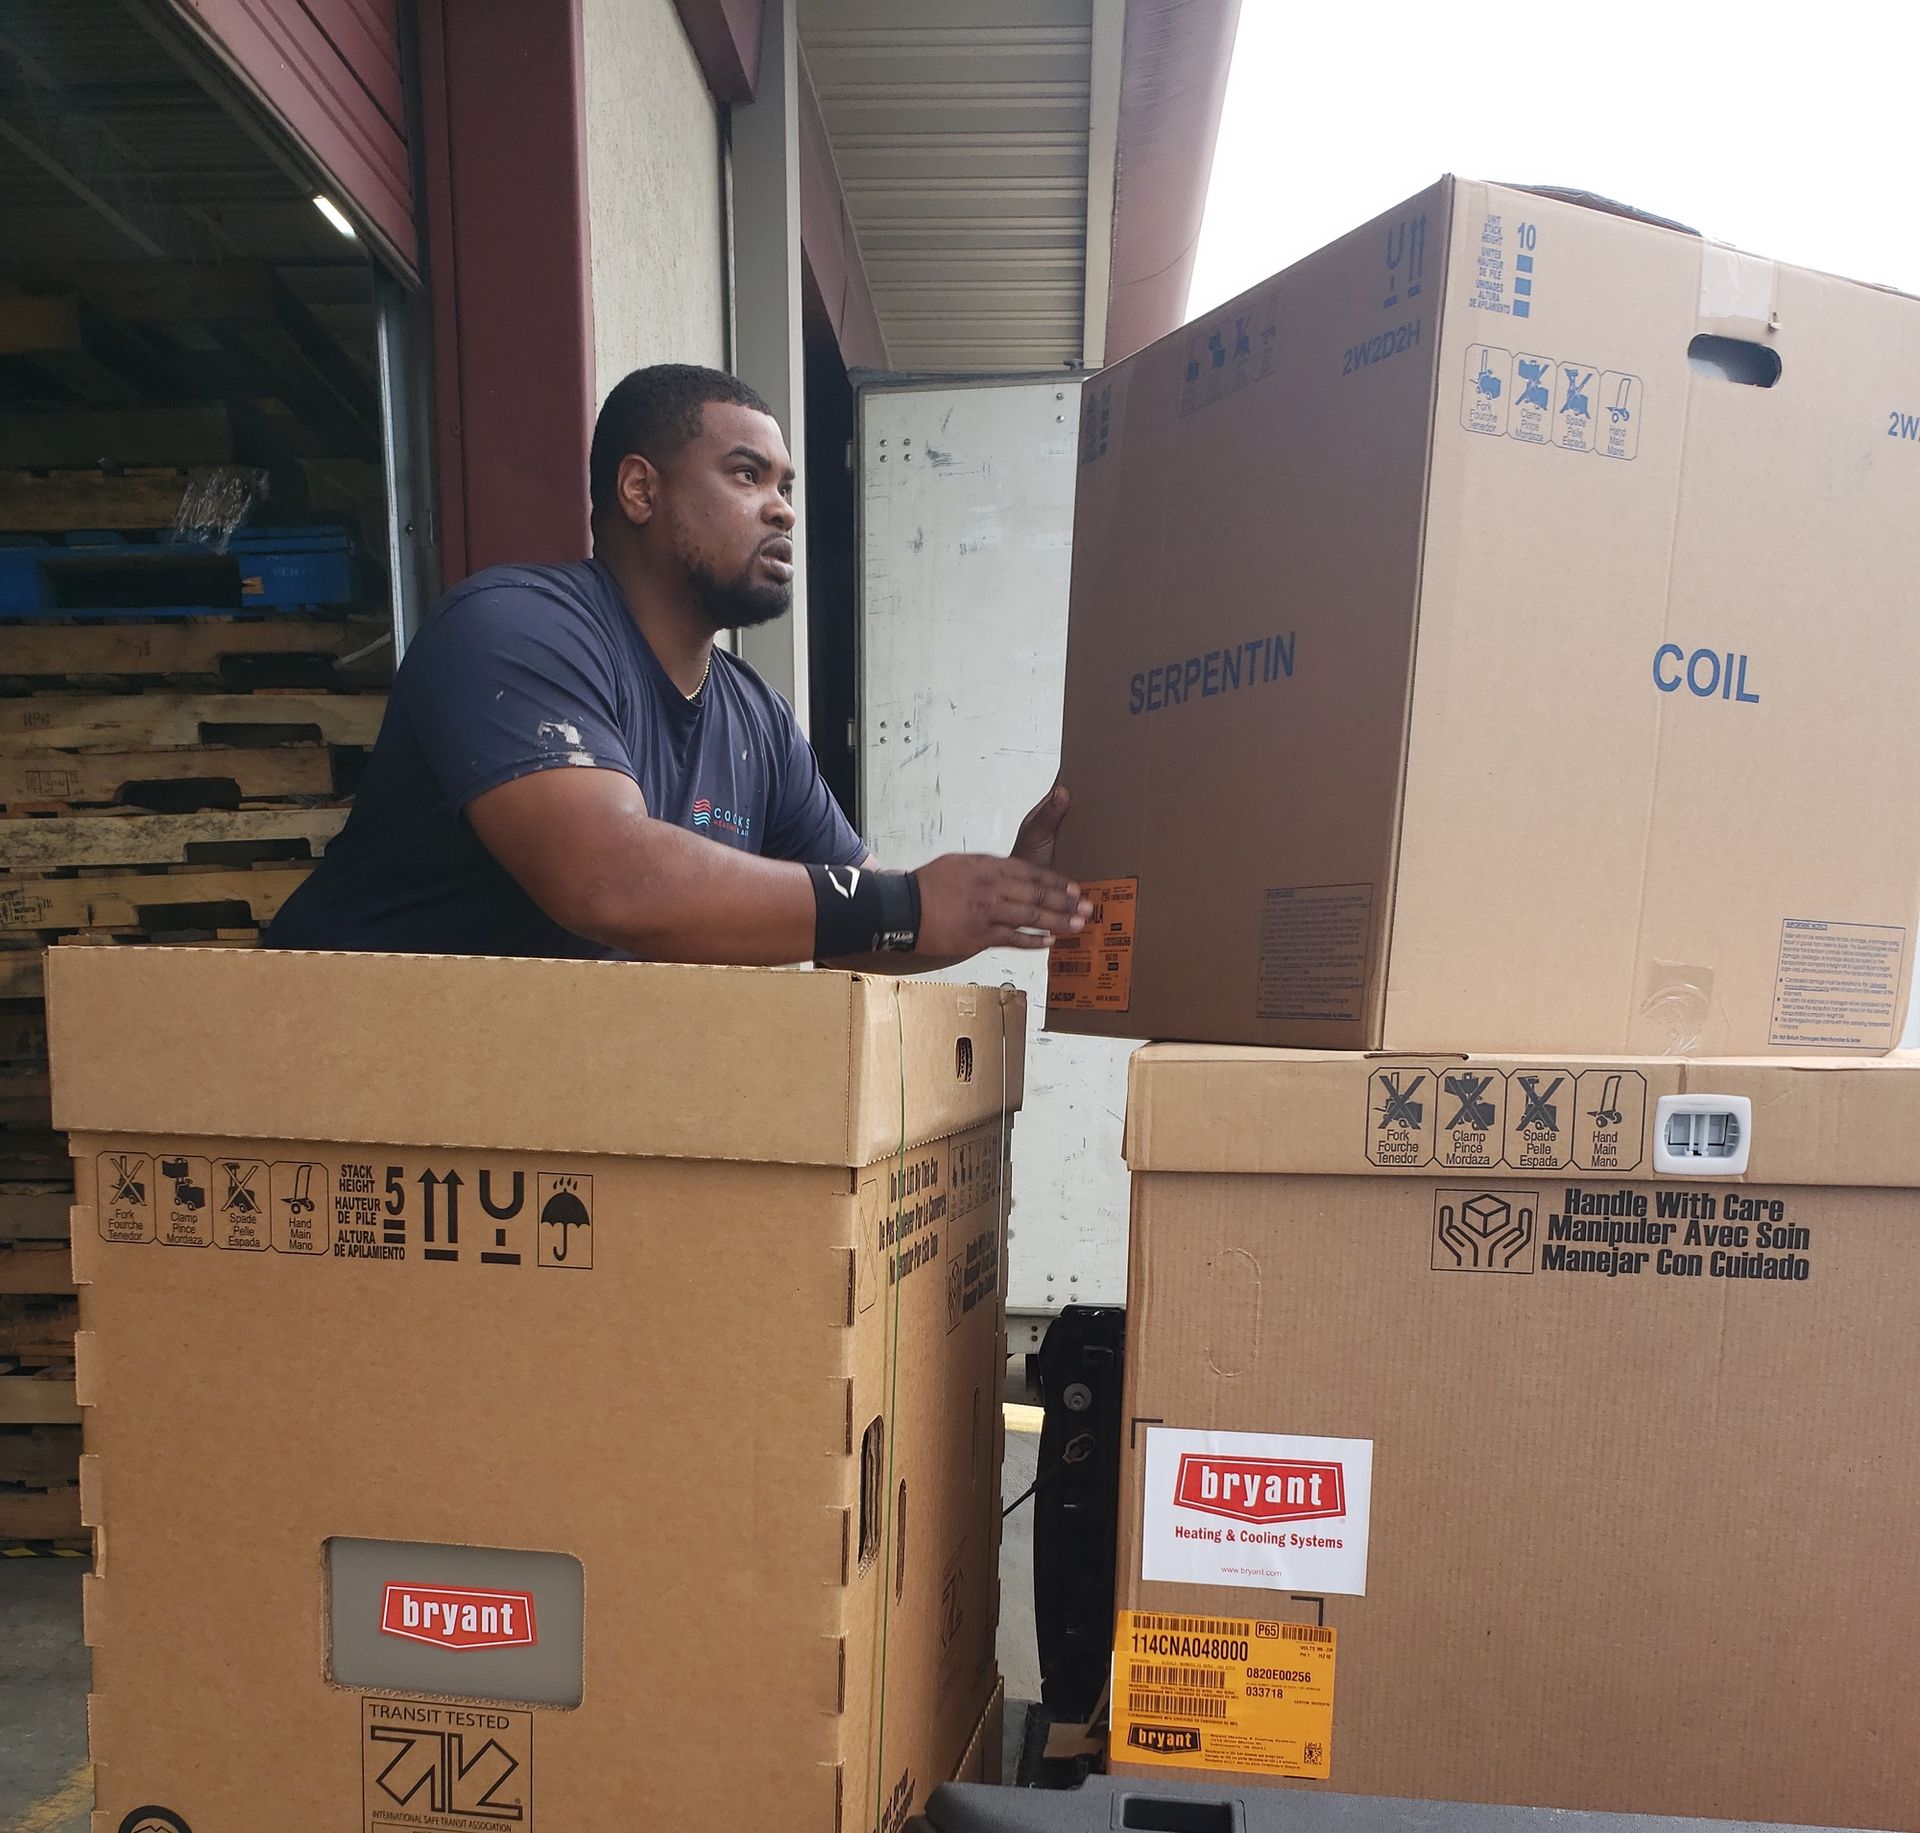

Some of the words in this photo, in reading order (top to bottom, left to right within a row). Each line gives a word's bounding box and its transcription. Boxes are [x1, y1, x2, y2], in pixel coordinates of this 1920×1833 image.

[1517, 222, 1537, 251] 10
[1480, 267, 1487, 277] DE
[1490, 269, 1501, 280] PILE
[1469, 298, 1477, 308] DE
[1342, 319, 1421, 376] 2W2D2H
[1476, 401, 1491, 411] Fork
[1470, 409, 1498, 422] Fourche
[1521, 409, 1542, 422] Clamp
[1566, 415, 1586, 428] Spade
[1469, 419, 1496, 432] Tenedor
[1521, 420, 1540, 431] Pince
[1609, 426, 1626, 437] Hand
[1888, 411, 1920, 443] 2W
[1567, 427, 1583, 438] Pelle
[1563, 436, 1586, 449] Espada
[1610, 435, 1625, 446] Main
[1608, 445, 1625, 456] Mano
[1128, 630, 1296, 715] SERPENTIN
[1653, 643, 1760, 704] COIL
[714, 807, 750, 829] COOKS
[1386, 1130, 1409, 1142] Fork
[1453, 1130, 1486, 1144] Clamp
[1523, 1129, 1556, 1144] Spade
[1592, 1130, 1617, 1143] Hand
[1378, 1141, 1419, 1153] Fourche
[1454, 1143, 1483, 1154] Pince
[1526, 1143, 1551, 1154] Pelle
[1594, 1143, 1616, 1155] Main
[1377, 1152, 1418, 1164] Tenedor
[1446, 1152, 1490, 1165] Mordaza
[1520, 1154, 1558, 1168] Espada
[1591, 1154, 1617, 1167] Mano
[341, 1164, 373, 1179] STACK
[339, 1179, 375, 1193] HEIGHT
[385, 1166, 405, 1216] 5
[335, 1196, 381, 1211] HAUTEUR
[1564, 1188, 1648, 1217] Handle
[1655, 1191, 1716, 1220] With
[1723, 1194, 1784, 1222] Care
[115, 1208, 135, 1220] Fork
[170, 1211, 198, 1224] Clamp
[229, 1212, 257, 1226] Spade
[338, 1211, 350, 1224] DE
[356, 1211, 377, 1226] PILE
[108, 1218, 144, 1230] Fourche
[172, 1223, 196, 1234] Pince
[289, 1218, 312, 1229] Hand
[108, 1229, 142, 1241] Tenedor
[233, 1225, 255, 1237] Pelle
[290, 1228, 312, 1240] Main
[338, 1229, 375, 1244] ALTURA
[1548, 1214, 1676, 1246] Manipuler
[1683, 1220, 1749, 1248] Avec
[1756, 1222, 1810, 1250] Soin
[166, 1233, 203, 1245] Mordaza
[229, 1236, 261, 1249] Espada
[289, 1239, 313, 1251] Mano
[334, 1243, 346, 1257] DE
[348, 1244, 406, 1260] APILAMIENTO
[1541, 1244, 1649, 1278] Manejar
[1656, 1249, 1703, 1277] Con
[1709, 1251, 1809, 1281] Cuidado
[1201, 1465, 1322, 1507] bryant
[1175, 1526, 1221, 1543] Heating
[1226, 1530, 1235, 1542] &
[1240, 1530, 1286, 1547] Cooling
[1290, 1533, 1343, 1549] Systems
[1221, 1566, 1282, 1578] www.bryant.com
[403, 1594, 513, 1635] bryant
[1258, 1624, 1277, 1637] P65
[1131, 1632, 1248, 1661] 114CNA048000
[1246, 1667, 1311, 1683] 0820E00256
[1246, 1687, 1284, 1699] 033718
[368, 1703, 442, 1725] TRANSIT
[448, 1711, 510, 1730] TESTED
[1138, 1727, 1192, 1748] bryant
[372, 1810, 422, 1824] INTERNATIONAL
[423, 1815, 440, 1826] SAFE
[441, 1817, 467, 1829] TRANSIT
[468, 1820, 512, 1833] ASSOCIATION
